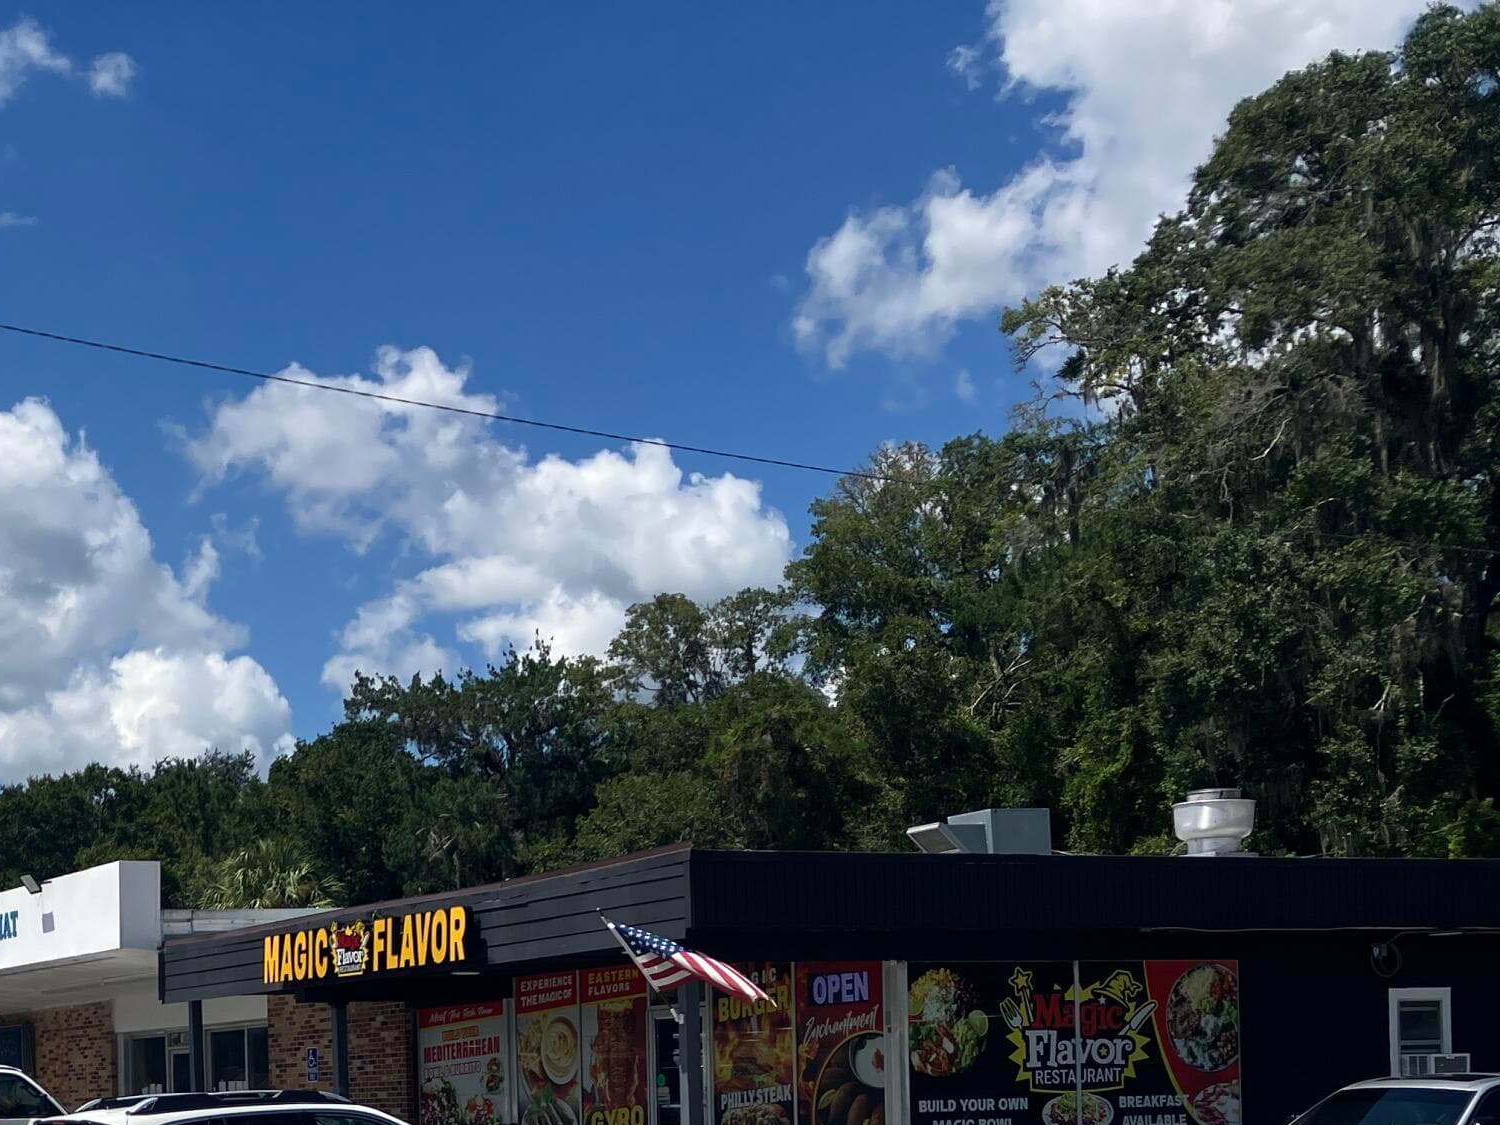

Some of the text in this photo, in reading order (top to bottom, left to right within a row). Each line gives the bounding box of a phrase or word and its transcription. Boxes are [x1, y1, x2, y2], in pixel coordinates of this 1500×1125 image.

[264, 905, 466, 984] MAGIC FLAVOR
[520, 974, 573, 992] EXPERIENCE
[588, 968, 639, 985] EASTERN
[812, 971, 869, 1005] OPEN
[520, 988, 573, 1007] THE MAGIC OF
[588, 982, 630, 996] FLAVORS
[718, 985, 789, 1022] BURGER
[1030, 993, 1124, 1036] Magic
[803, 1004, 879, 1046] Enchantment
[423, 1035, 500, 1065] MEDITERRANEAN
[1025, 1029, 1133, 1068] Flavor
[451, 1061, 481, 1076] BURRITO
[1035, 1068, 1122, 1085] RESTAURANT
[721, 1083, 792, 1110] PHILLY STEAK
[918, 1097, 1029, 1113] BUILD YOUR OWN
[1118, 1094, 1189, 1108] BREAKFAST
